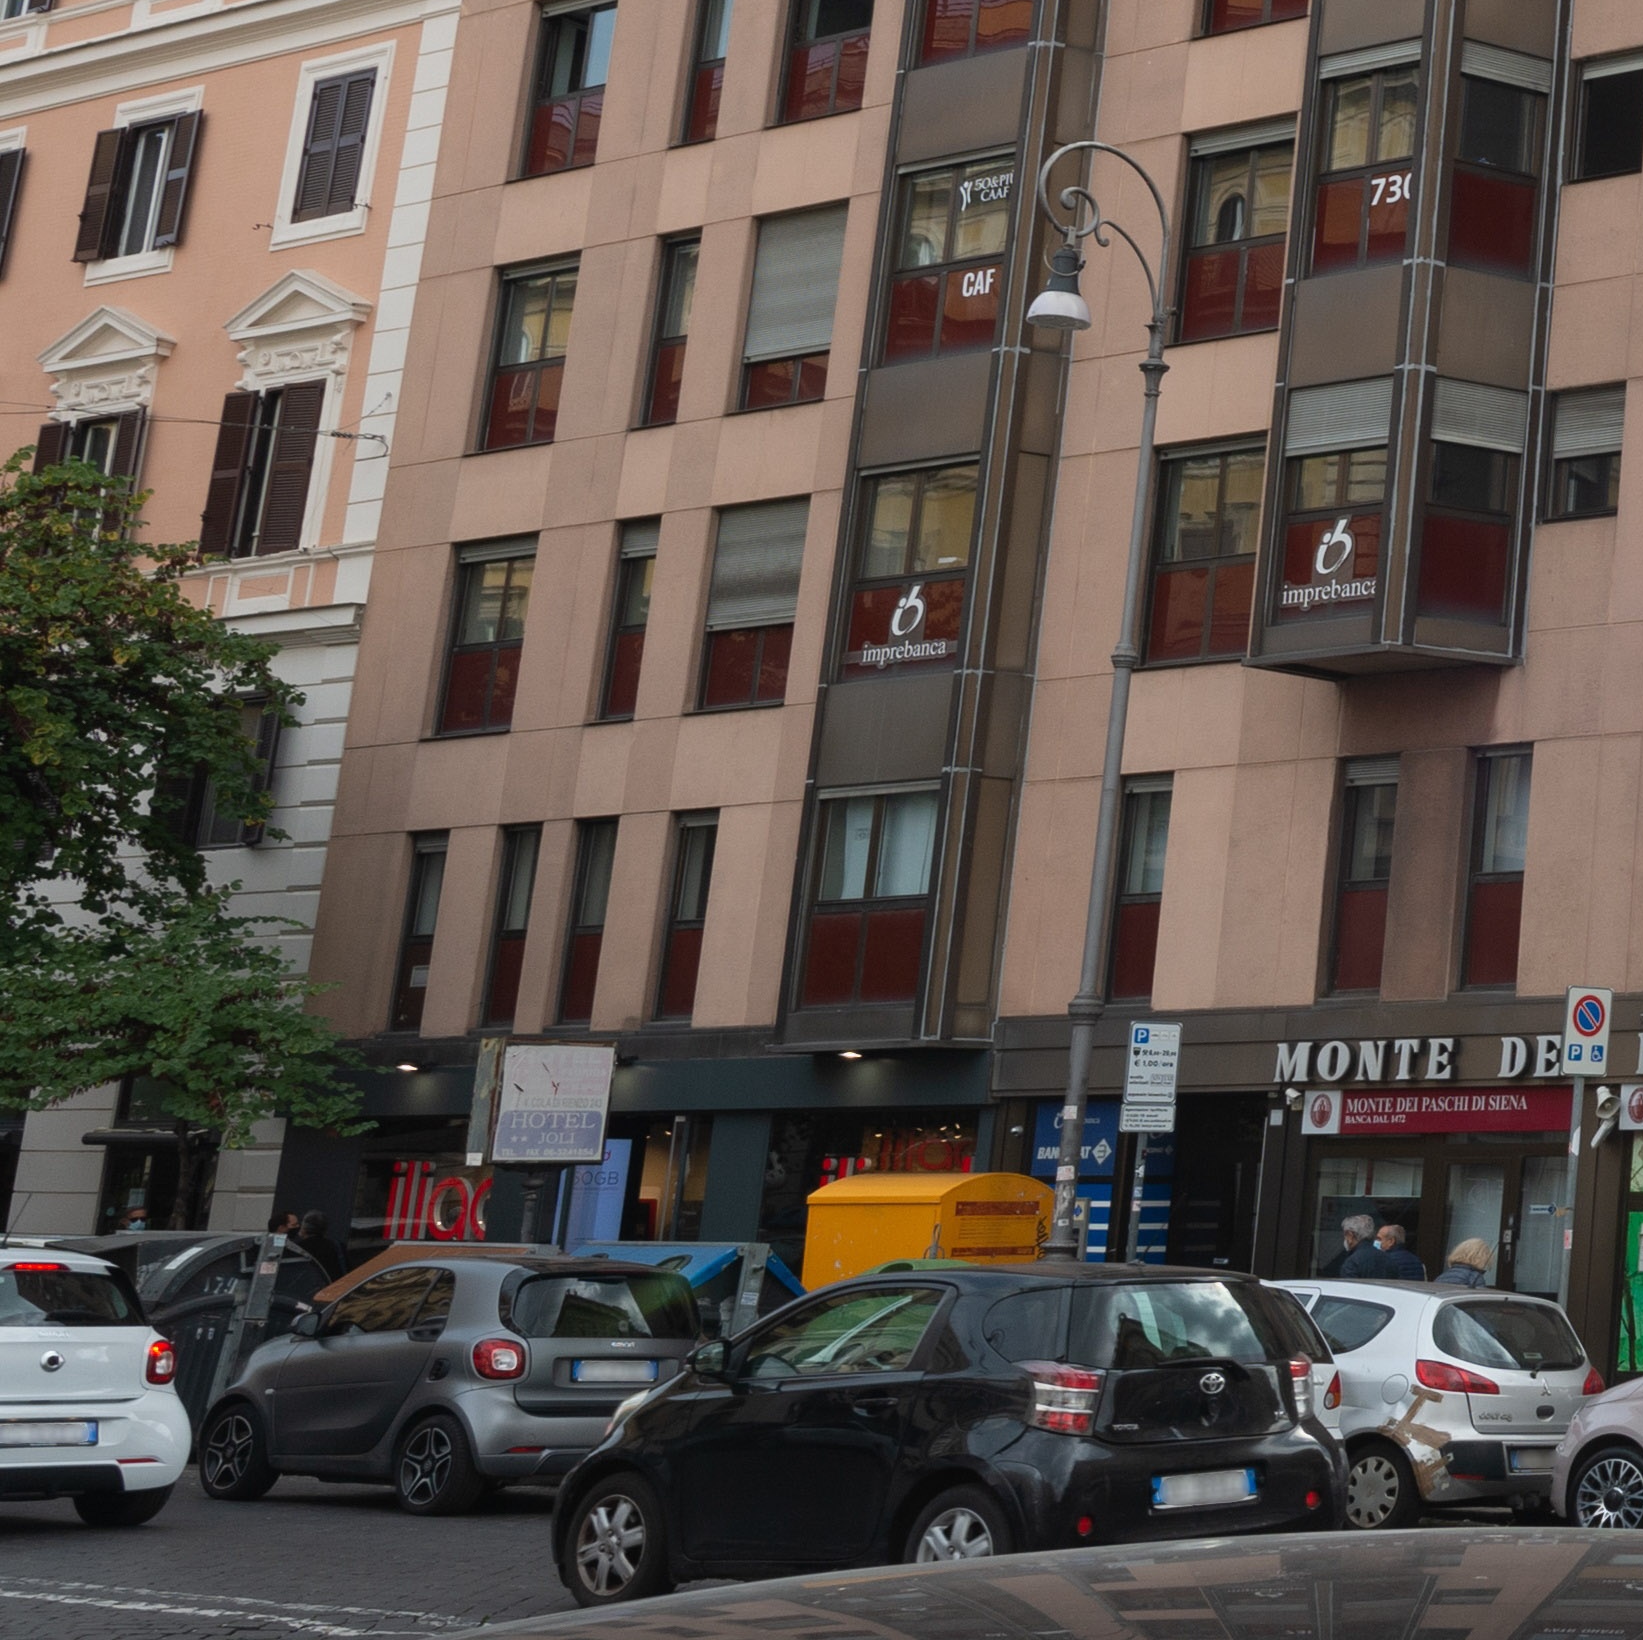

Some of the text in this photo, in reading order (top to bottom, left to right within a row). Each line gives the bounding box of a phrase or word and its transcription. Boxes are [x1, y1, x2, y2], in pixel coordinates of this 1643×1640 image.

[980, 186, 1010, 202] CAAF
[962, 268, 996, 298] CAF
[862, 640, 946, 666] imprebanca
[1273, 1037, 1455, 1083] MONTE
[1497, 1034, 1563, 1078] DE
[1346, 1095, 1528, 1114] MONTE DEI PASCHI DI SIENA
[510, 1111, 596, 1129] HOTEL
[537, 1131, 575, 1145] JOLI
[1037, 1145, 1092, 1160] BANAT
